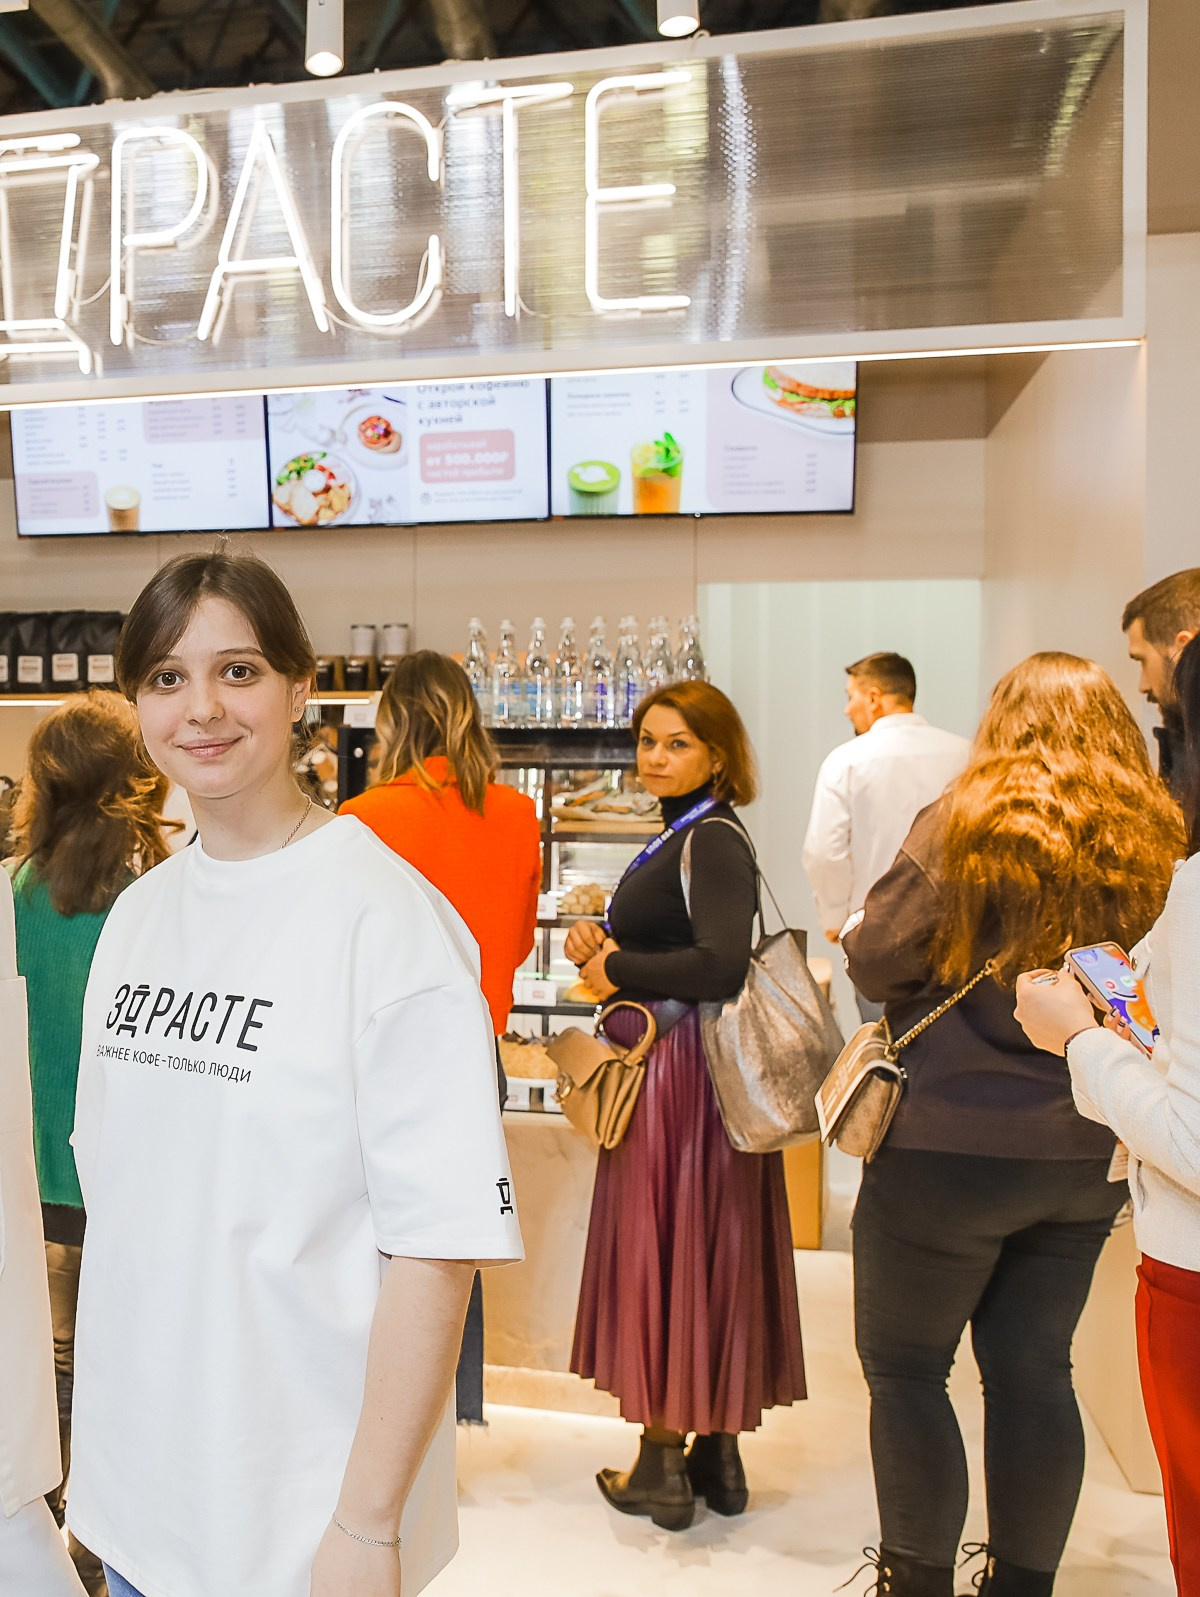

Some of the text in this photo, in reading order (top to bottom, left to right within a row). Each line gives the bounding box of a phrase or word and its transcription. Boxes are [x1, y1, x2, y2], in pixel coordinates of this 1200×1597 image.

[105, 984, 274, 1052] ЗДРАСТЕ
[96, 1044, 131, 1061] ВАЖНЕЕ
[208, 1062, 252, 1084] ЛЮДИ
